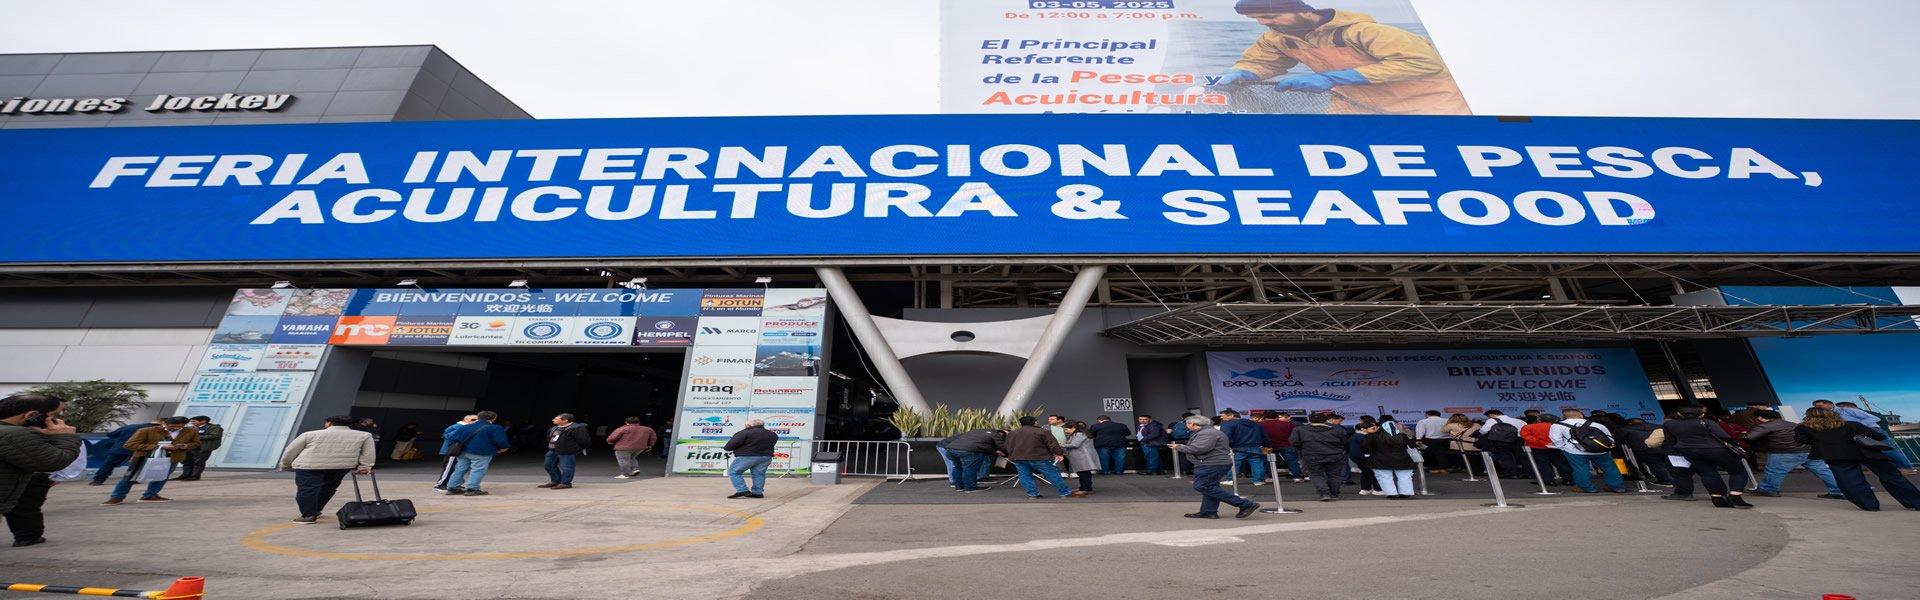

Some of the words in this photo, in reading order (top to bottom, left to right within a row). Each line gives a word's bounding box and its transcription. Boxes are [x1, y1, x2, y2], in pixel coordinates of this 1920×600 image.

[1034, 0, 1107, 9] 03-05,
[1113, 0, 1170, 9] 2025
[1161, 13, 1204, 21] p.m.
[981, 39, 1010, 50] El
[1019, 38, 1157, 51] Principal
[982, 54, 1135, 65] Referente
[982, 73, 1022, 84] de
[1031, 73, 1060, 84] la
[1070, 70, 1194, 84] Pesca
[1203, 74, 1223, 86] y
[0, 96, 127, 113] iones
[144, 93, 294, 111] Jockey
[982, 89, 1228, 106] Acuicultura
[90, 152, 369, 187] FERIA
[404, 144, 1273, 182] INTERNACIONAL
[1300, 145, 1436, 177] DE
[1457, 146, 1822, 187] PESCA,
[250, 182, 1018, 225] ACUICULTURA
[1051, 184, 1128, 219] &
[1162, 190, 1655, 226] SEAFOOD
[376, 292, 531, 303] BIENVENIDOS
[554, 292, 674, 303] WELCOME
[485, 303, 553, 313] 欢迎光临
[1284, 355, 1383, 363] INTERNACIONAL
[1404, 354, 1448, 362] PESCA,
[1447, 365, 1607, 376] BIENVENIDOS
[692, 376, 717, 385] nu
[1262, 379, 1304, 387] PESCA
[1320, 379, 1400, 387] ACUIPERU
[1476, 379, 1588, 390] WELCOME
[691, 385, 734, 395] maq
[1275, 389, 1319, 400] Seafood
[1322, 391, 1352, 400] Lima
[1496, 391, 1576, 402] 欢迎光临
[1106, 399, 1131, 409] AFORO
